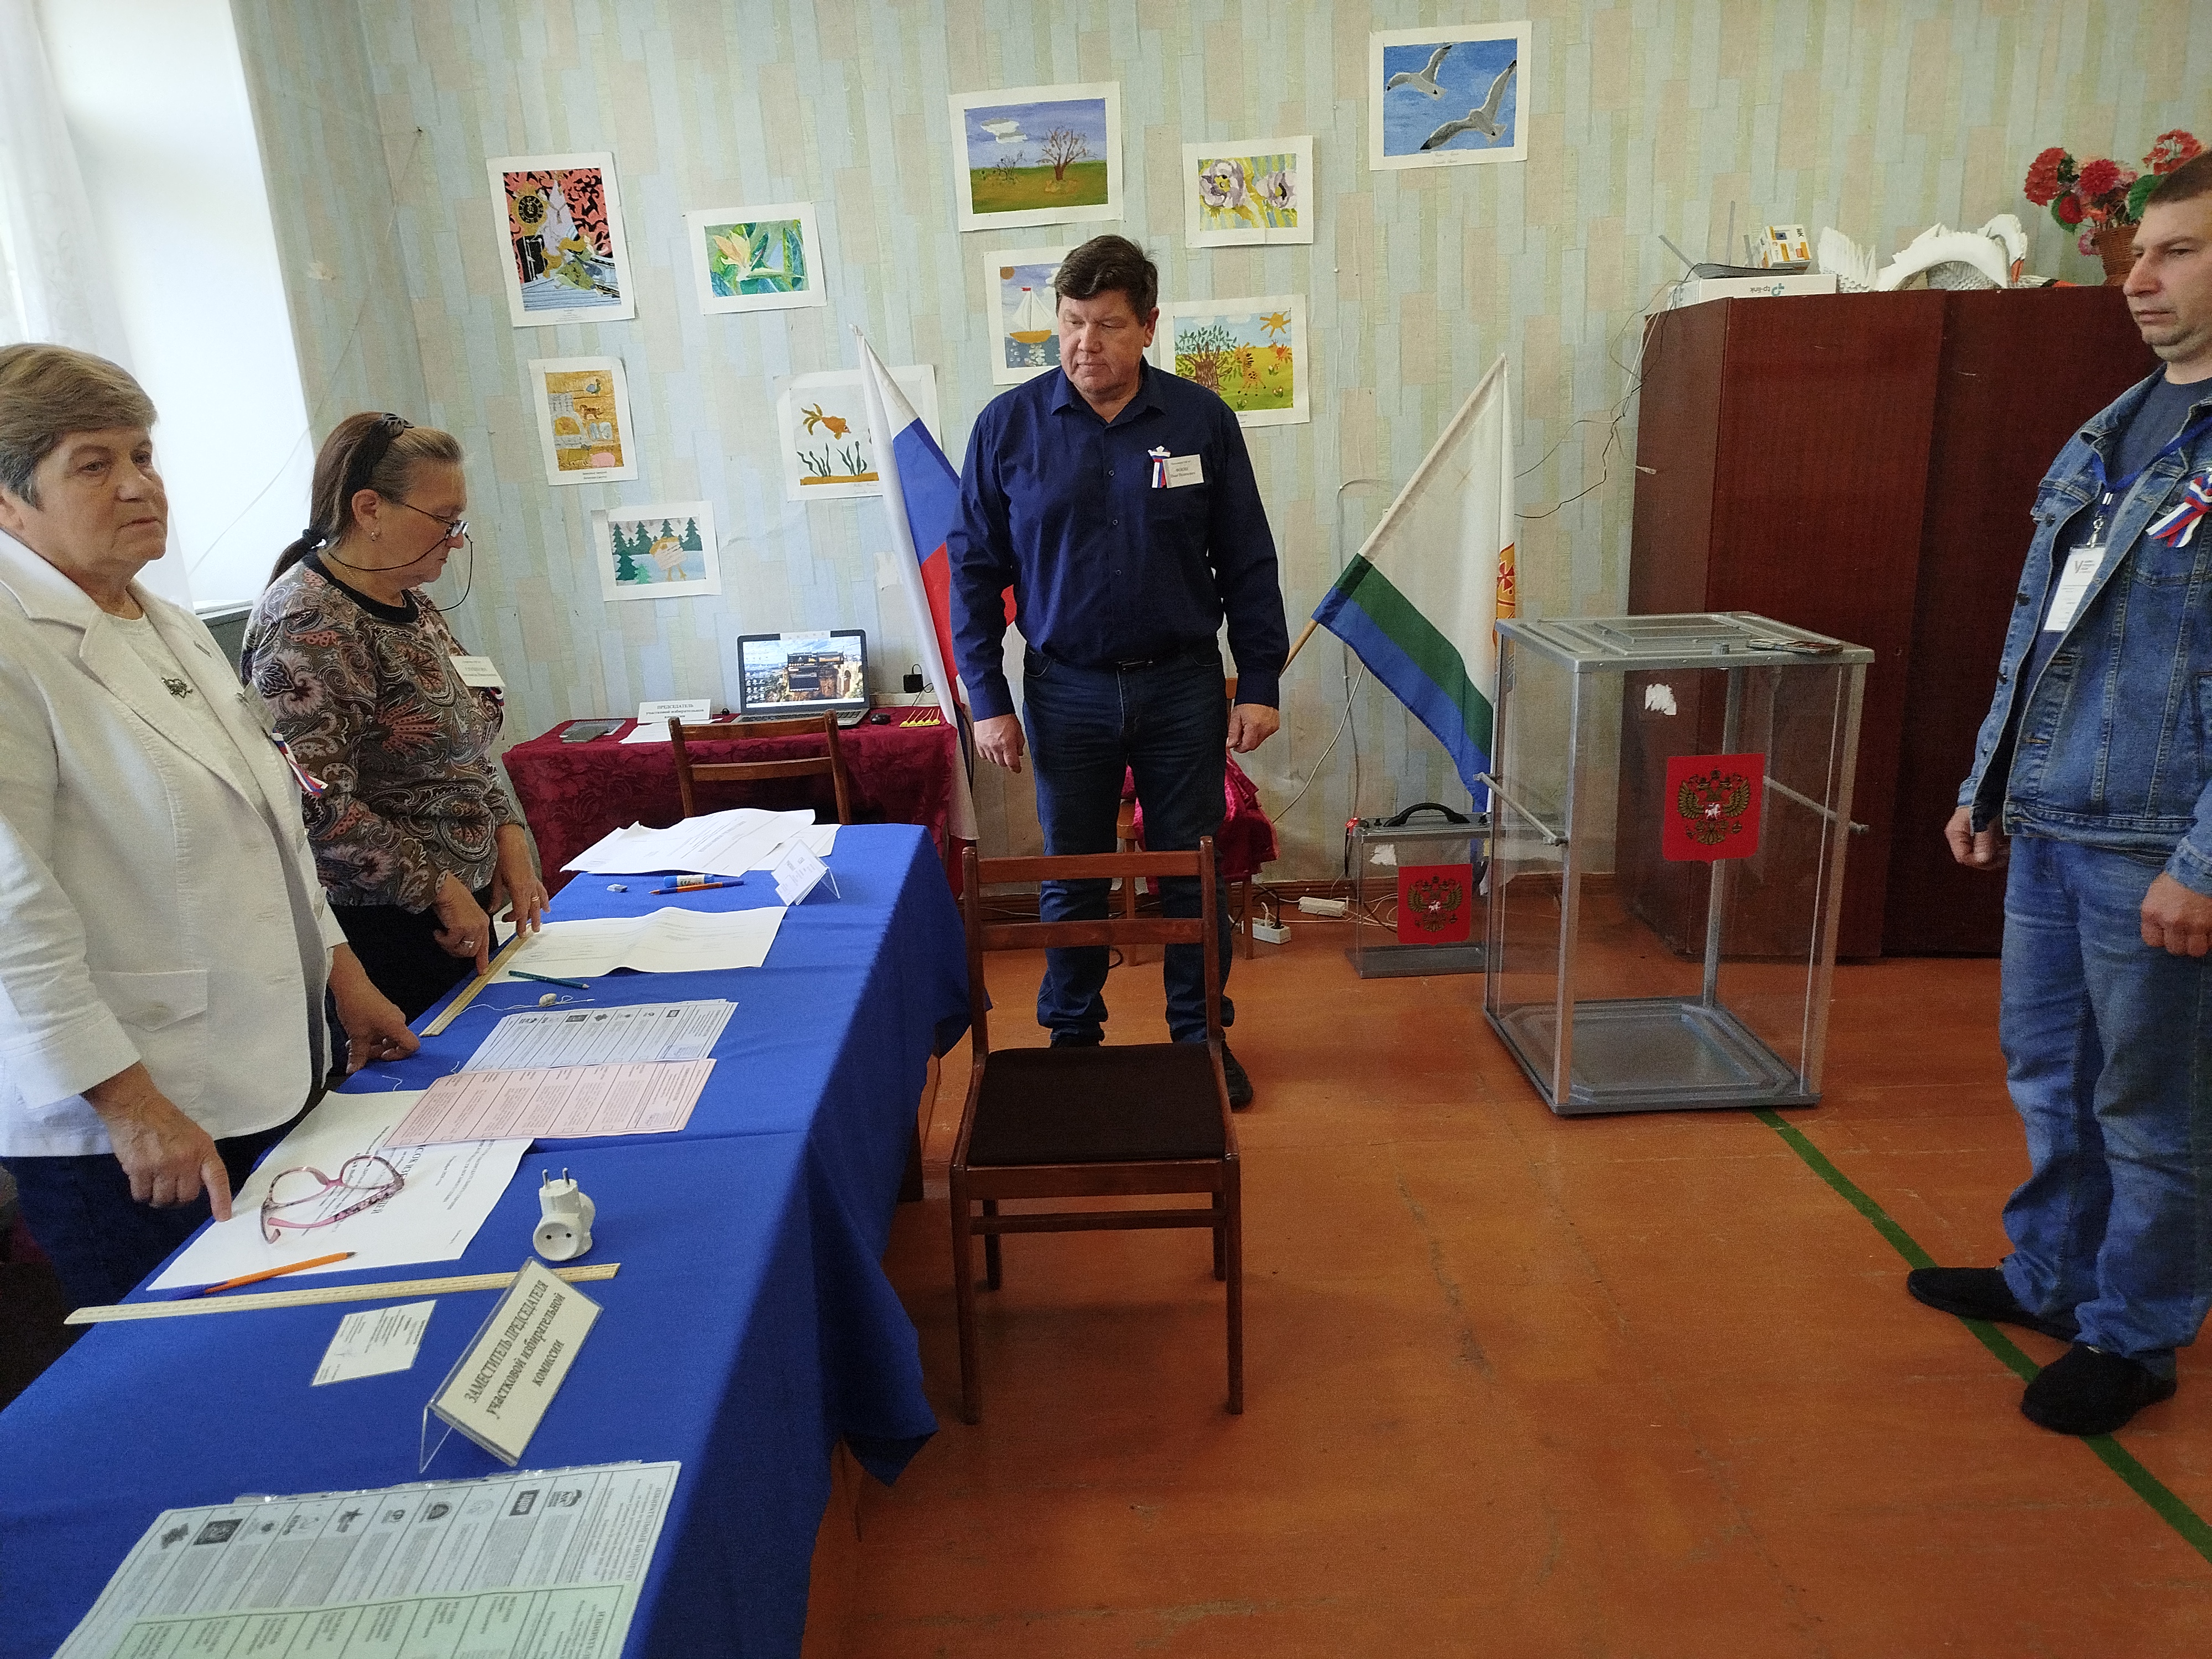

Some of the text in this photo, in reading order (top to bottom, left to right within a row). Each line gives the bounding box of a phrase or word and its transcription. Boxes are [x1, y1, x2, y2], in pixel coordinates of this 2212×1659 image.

[463, 1279, 549, 1404] ЗАМЕСТИТЕЛЬ ПРЕДСЕДАТЕЛЯ
[486, 1292, 566, 1420] участковой избирательной
[532, 1338, 565, 1387] комиссии
